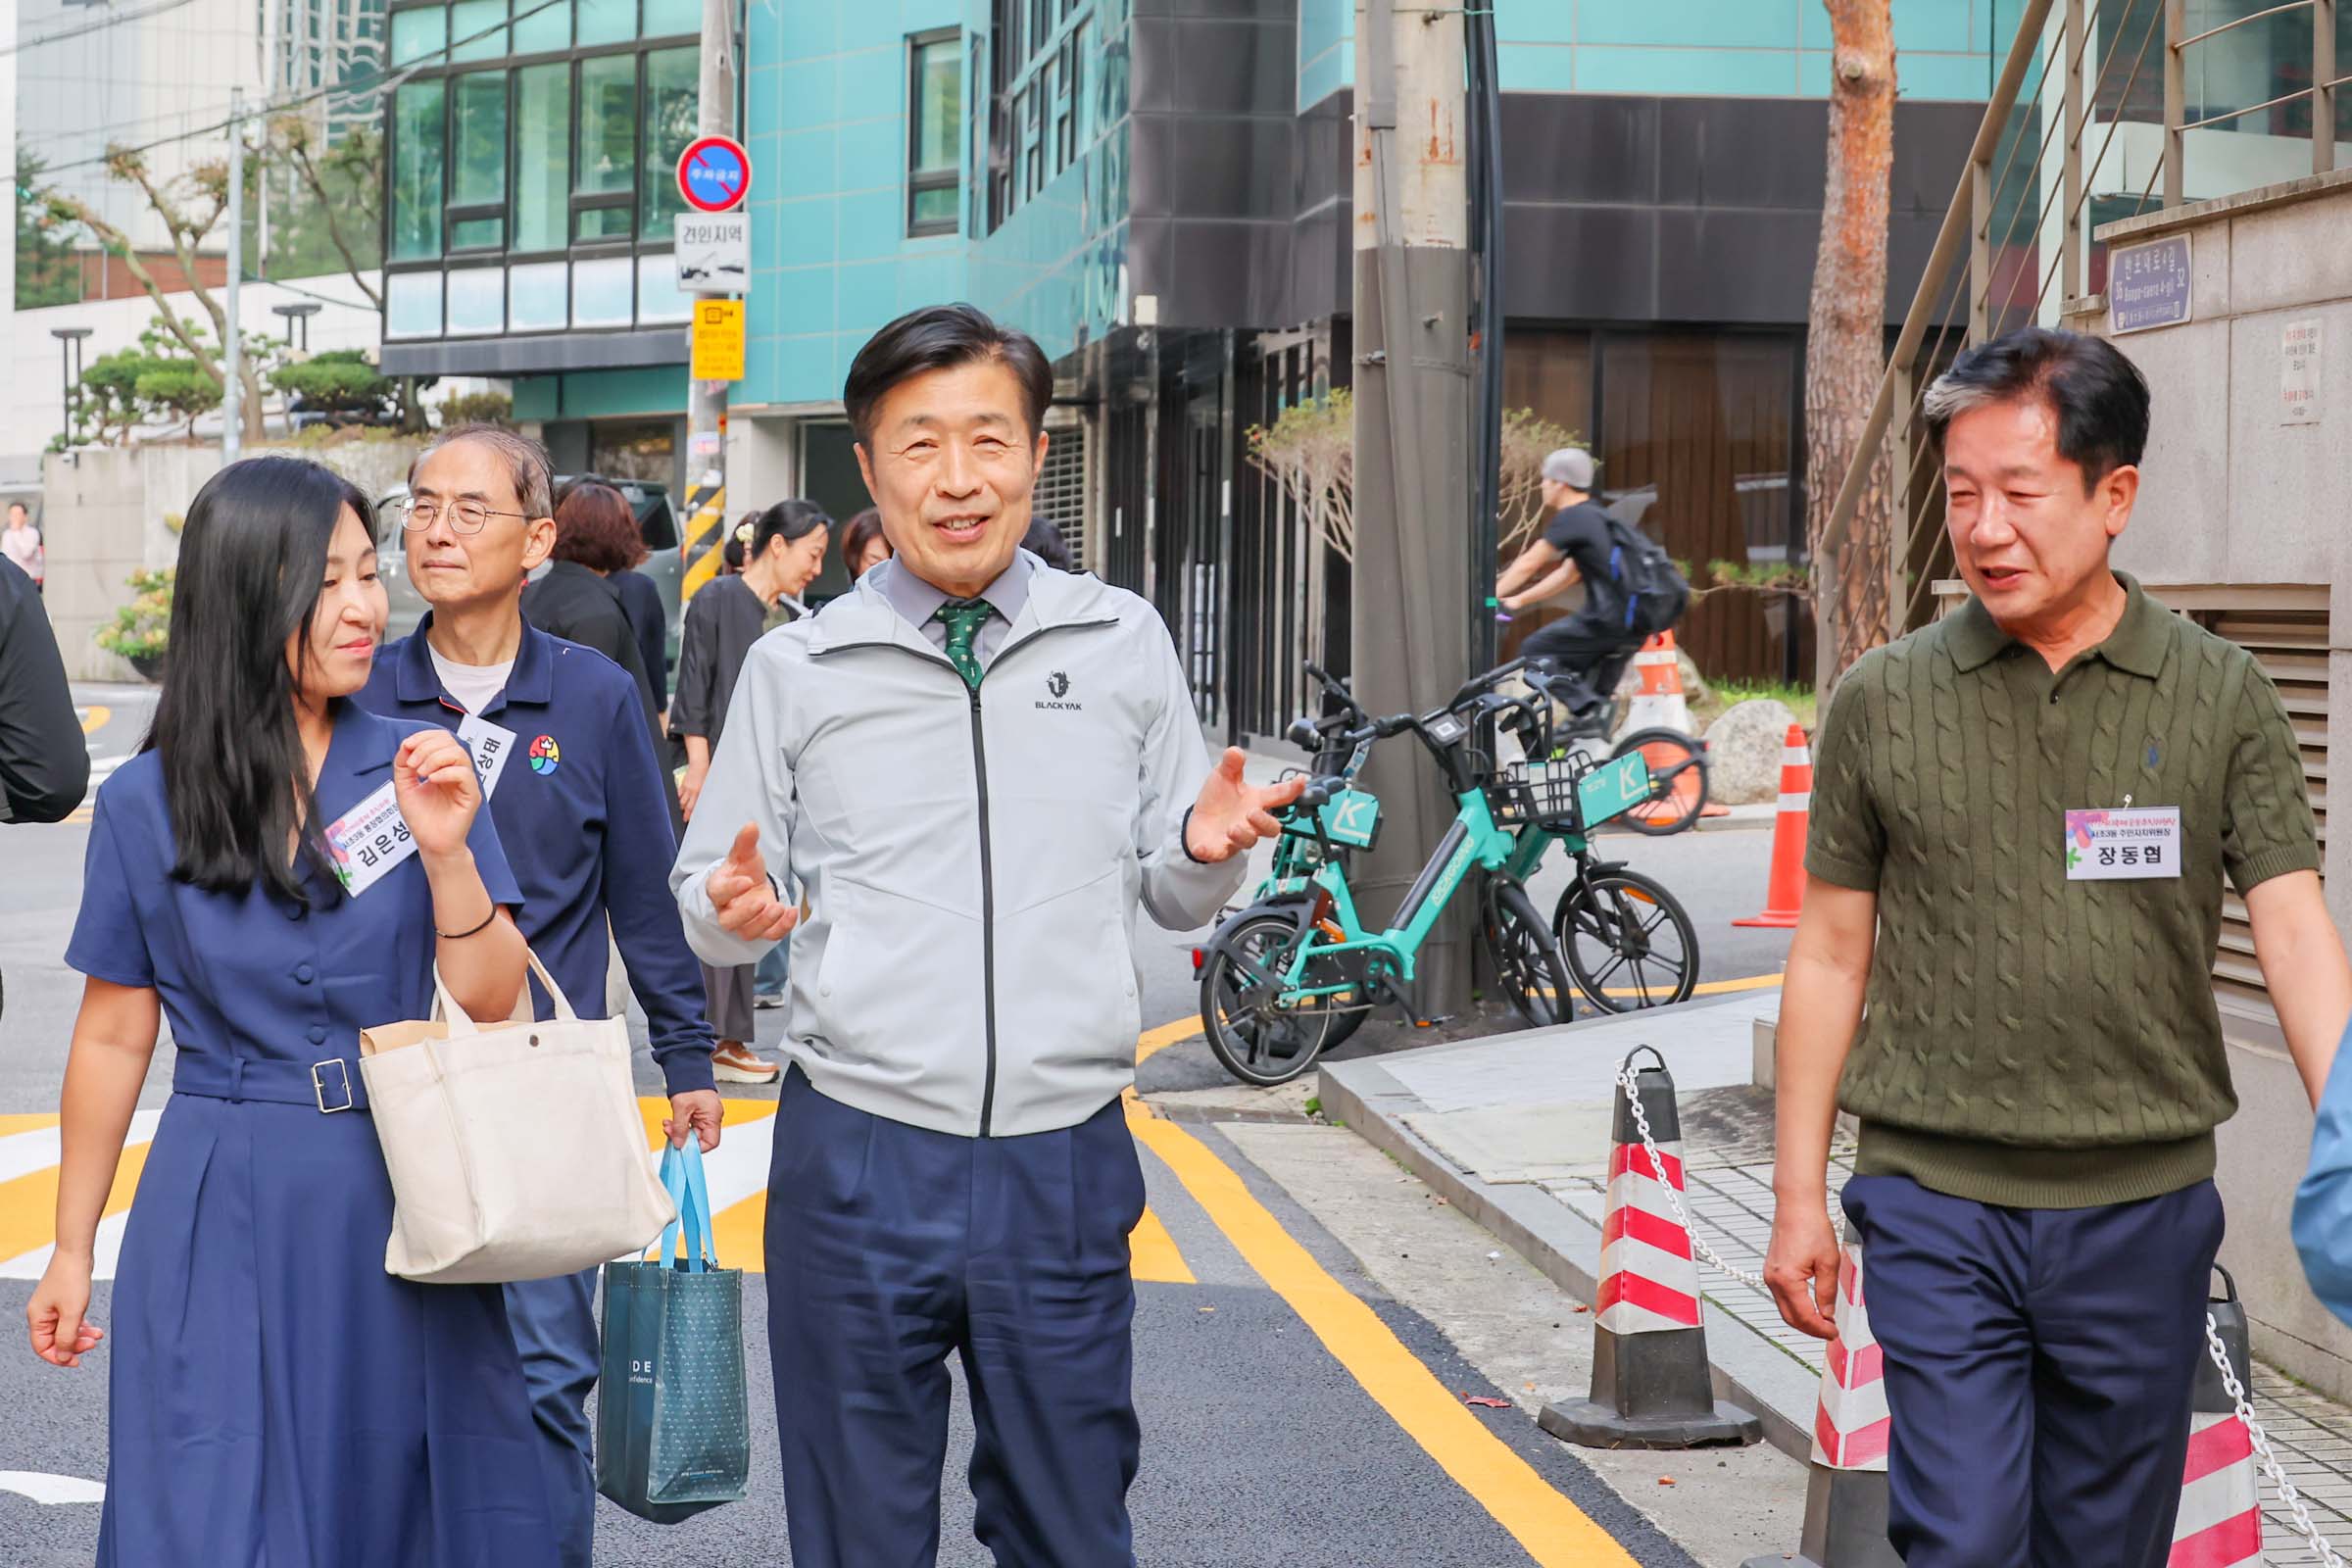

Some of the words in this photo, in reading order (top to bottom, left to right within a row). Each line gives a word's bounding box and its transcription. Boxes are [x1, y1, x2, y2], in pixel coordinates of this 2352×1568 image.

[683, 224, 742, 244] 견인지역
[476, 737, 502, 785] 상태
[357, 820, 411, 867] 김은성
[2098, 845, 2162, 865] 장동협
[629, 1360, 652, 1373] DE
[628, 1374, 653, 1384] nfidence
